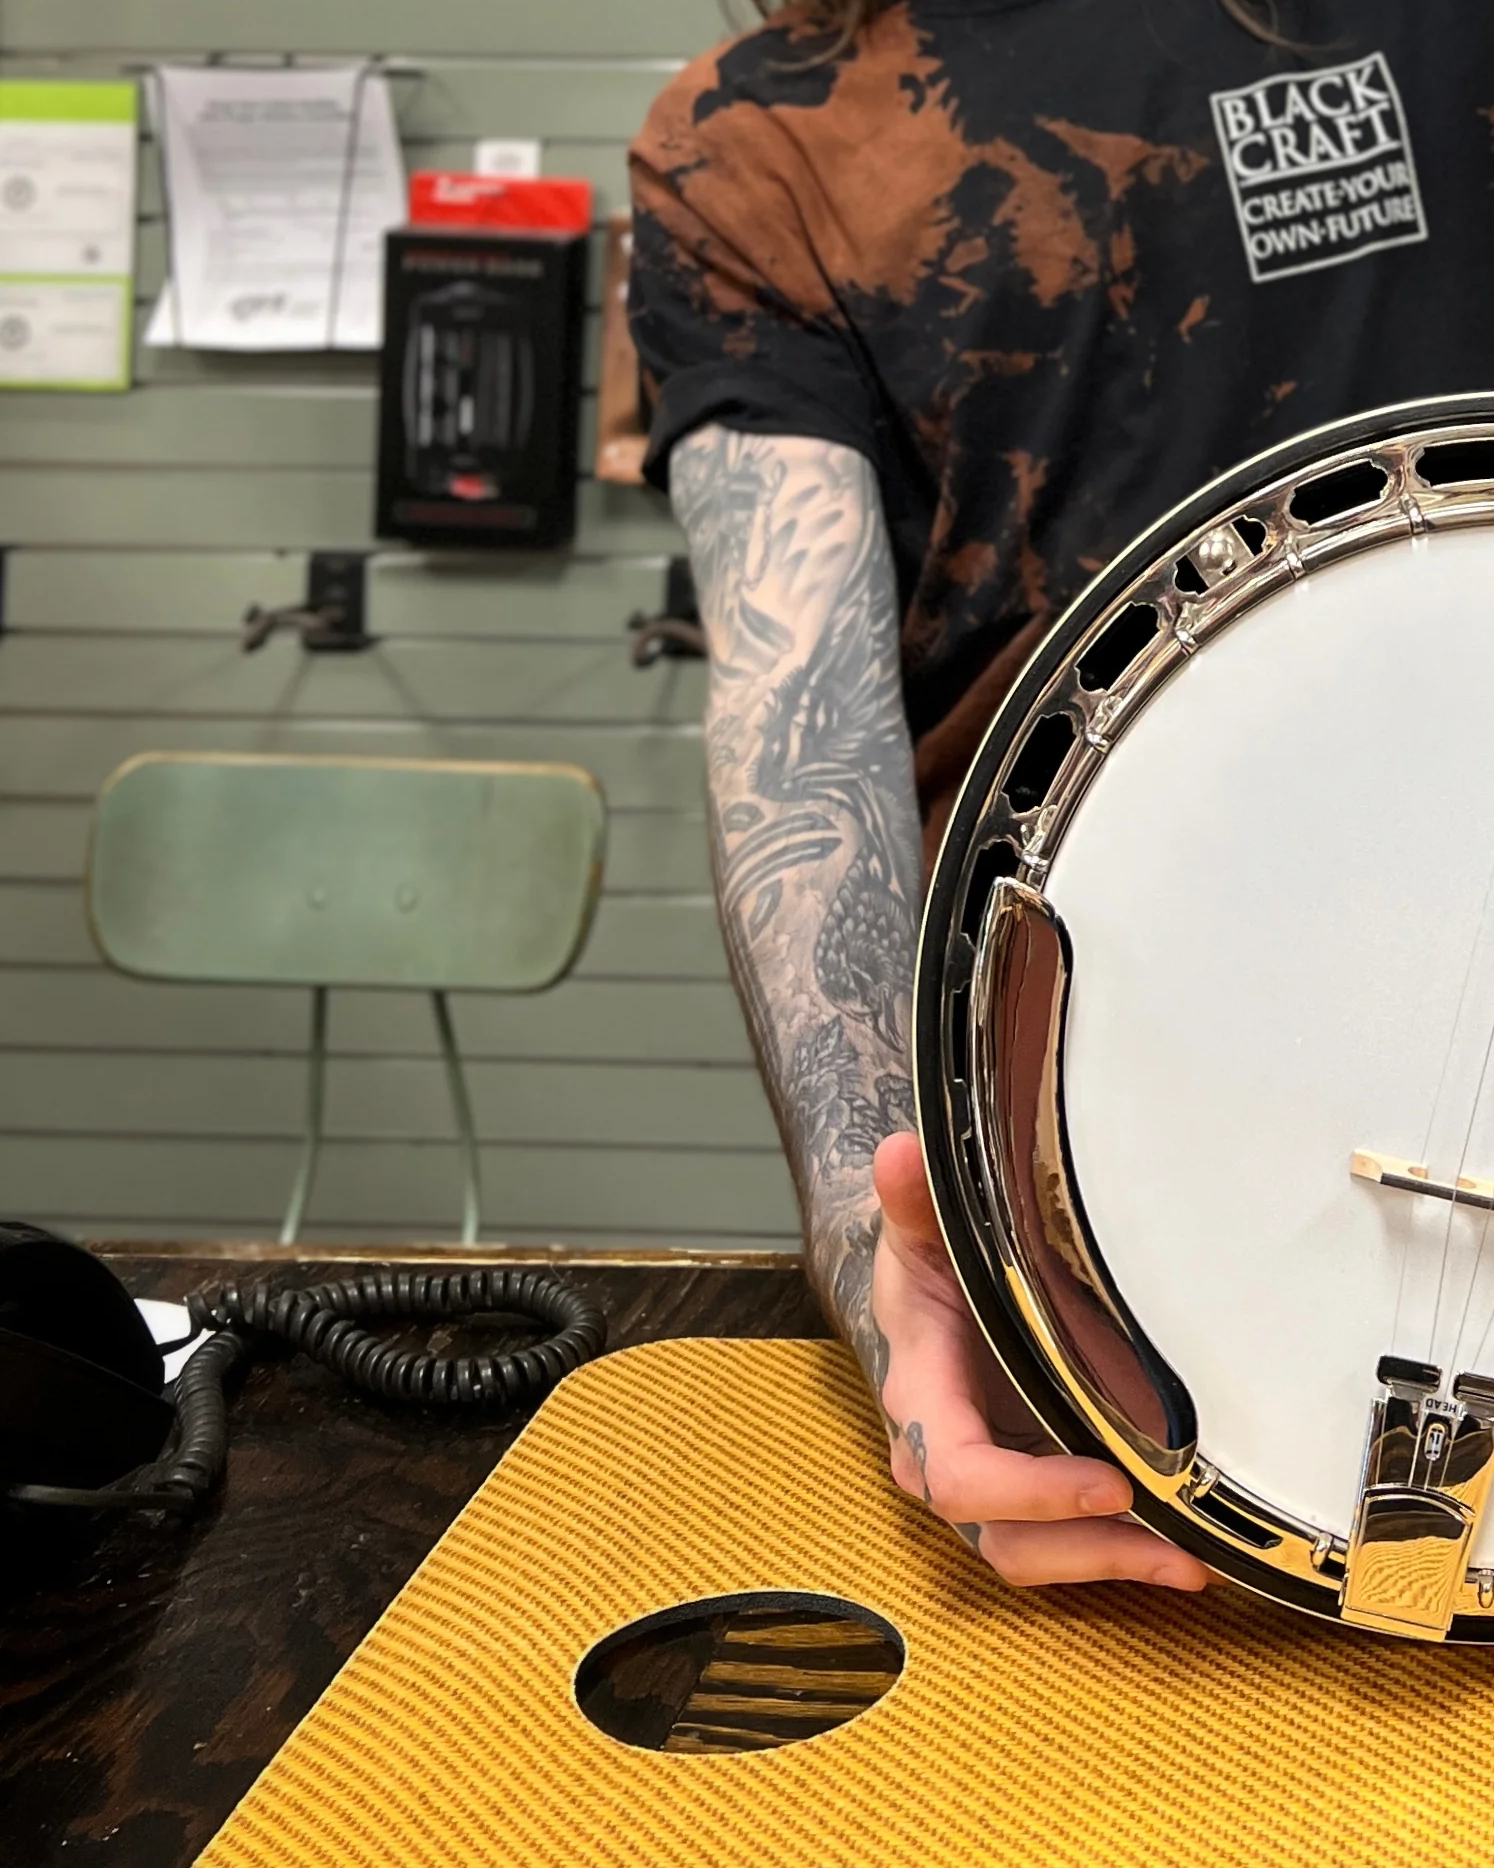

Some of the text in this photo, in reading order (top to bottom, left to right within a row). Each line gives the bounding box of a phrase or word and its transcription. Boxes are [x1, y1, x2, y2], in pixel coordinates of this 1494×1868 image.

[1222, 65, 1388, 141] BLACK
[1232, 100, 1391, 178] CRAFT
[1425, 1398, 1457, 1413] HEAD
